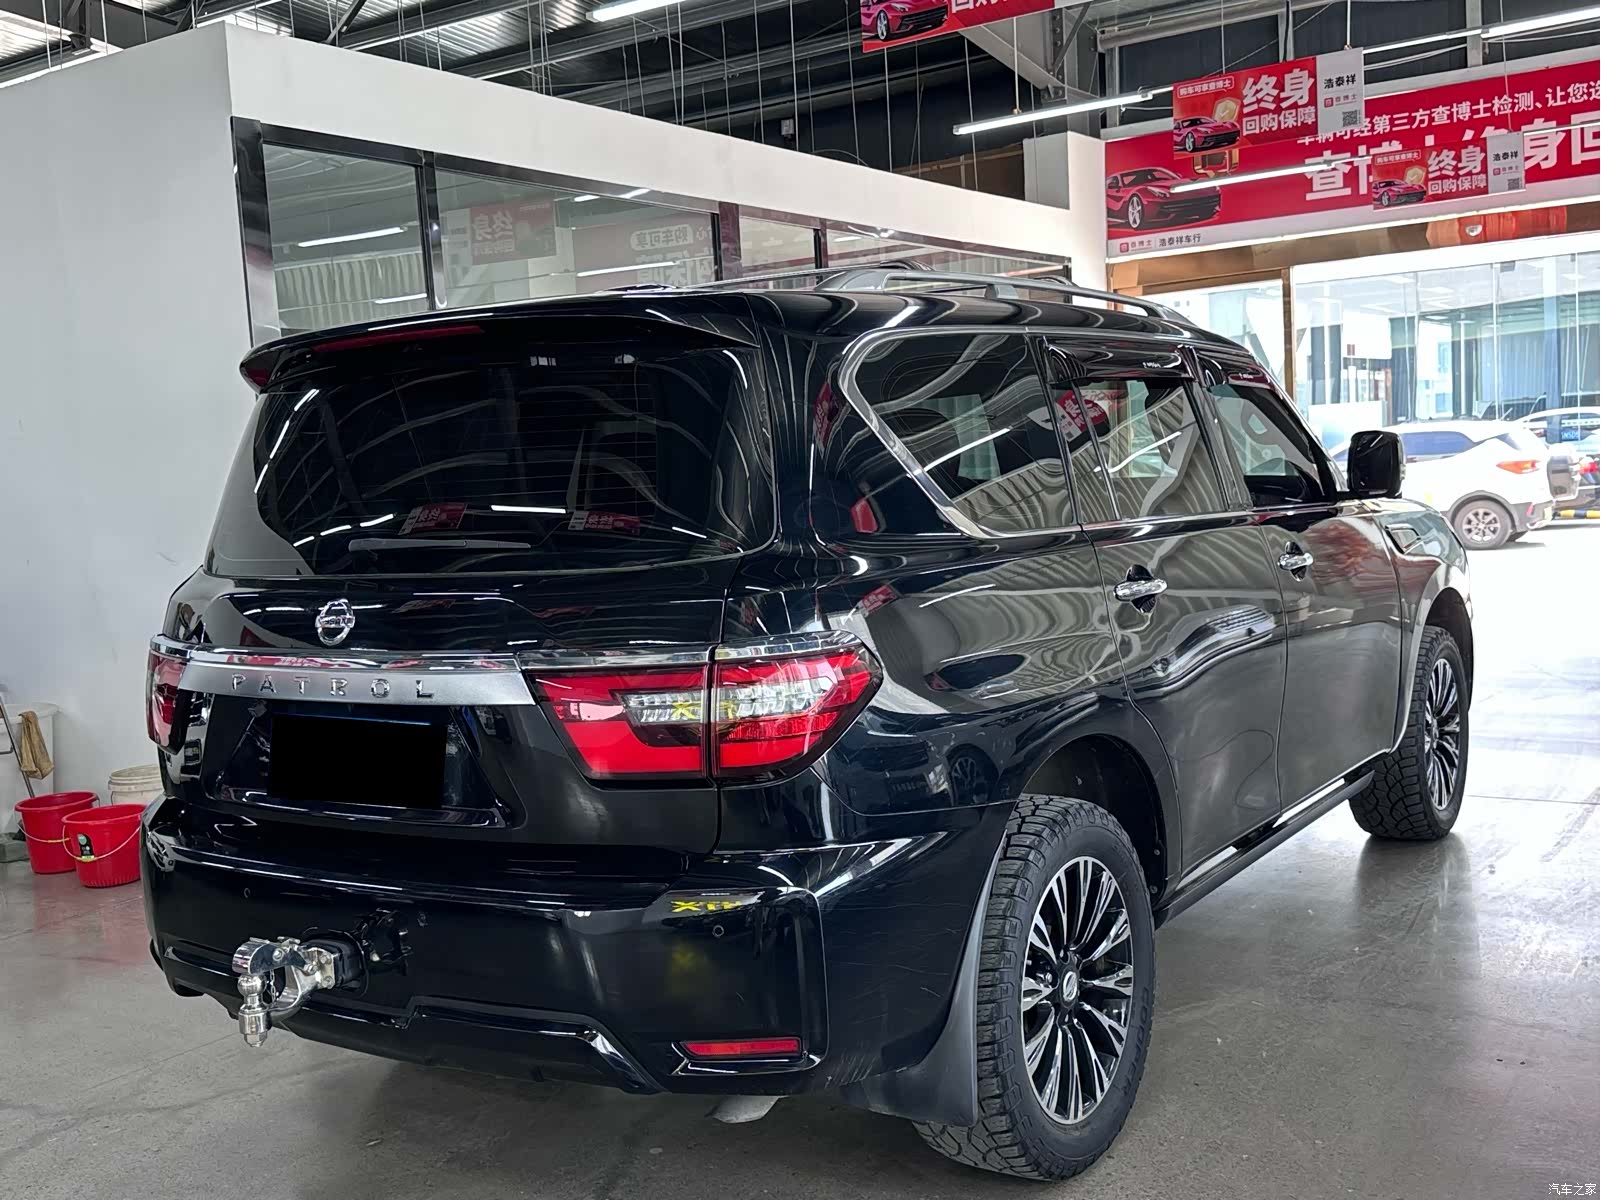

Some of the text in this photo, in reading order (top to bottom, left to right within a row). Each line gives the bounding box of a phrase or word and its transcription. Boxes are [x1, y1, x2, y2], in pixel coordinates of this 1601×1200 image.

[1242, 68, 1314, 113] 终身
[1323, 74, 1356, 89] 浩泰祥
[1242, 106, 1316, 136] 回购保障
[1428, 145, 1485, 179] 终身
[1428, 174, 1487, 195] 回购保障
[1159, 233, 1201, 248] 浩泰祥车行
[231, 672, 435, 699] PATROL
